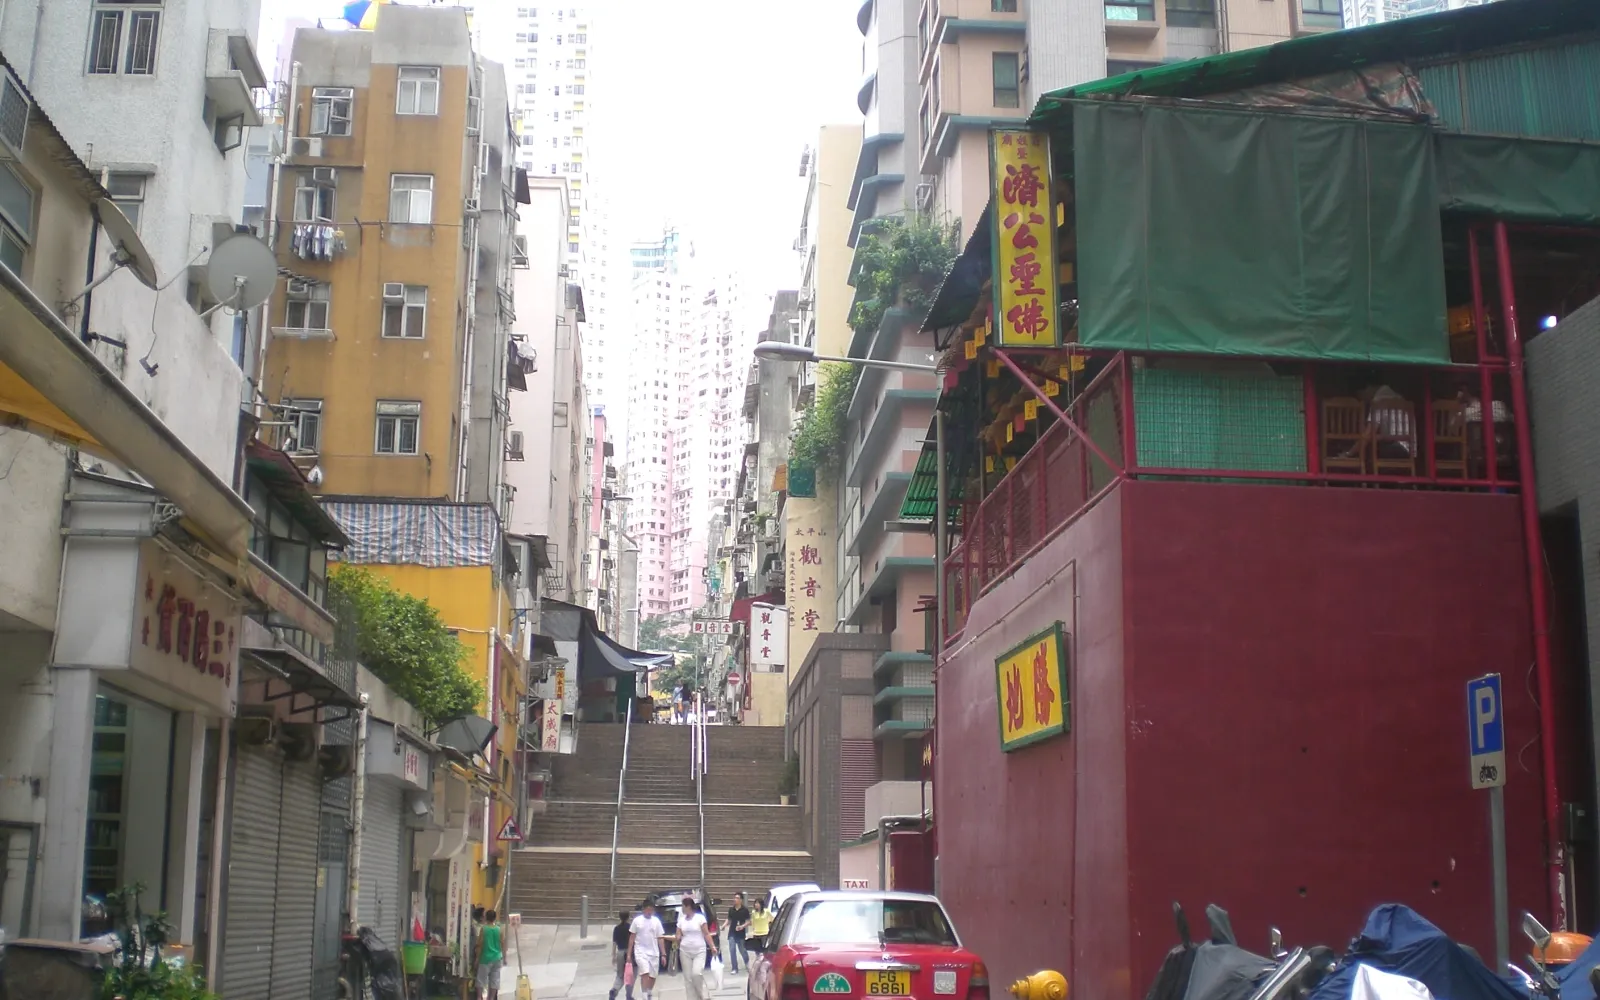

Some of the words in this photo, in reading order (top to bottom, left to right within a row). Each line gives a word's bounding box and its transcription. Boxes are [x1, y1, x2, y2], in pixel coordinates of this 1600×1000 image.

[1003, 163, 1048, 340] 濟公聖佛
[795, 527, 827, 537] 太平山
[798, 543, 822, 632] 觀音堂
[694, 622, 732, 633] 觀音堂
[760, 612, 773, 658] 觀音堂
[1475, 686, 1496, 749] P
[844, 880, 869, 889] TAXI
[828, 979, 835, 987] 5
[878, 971, 897, 983] FG
[870, 982, 905, 995] 6861
